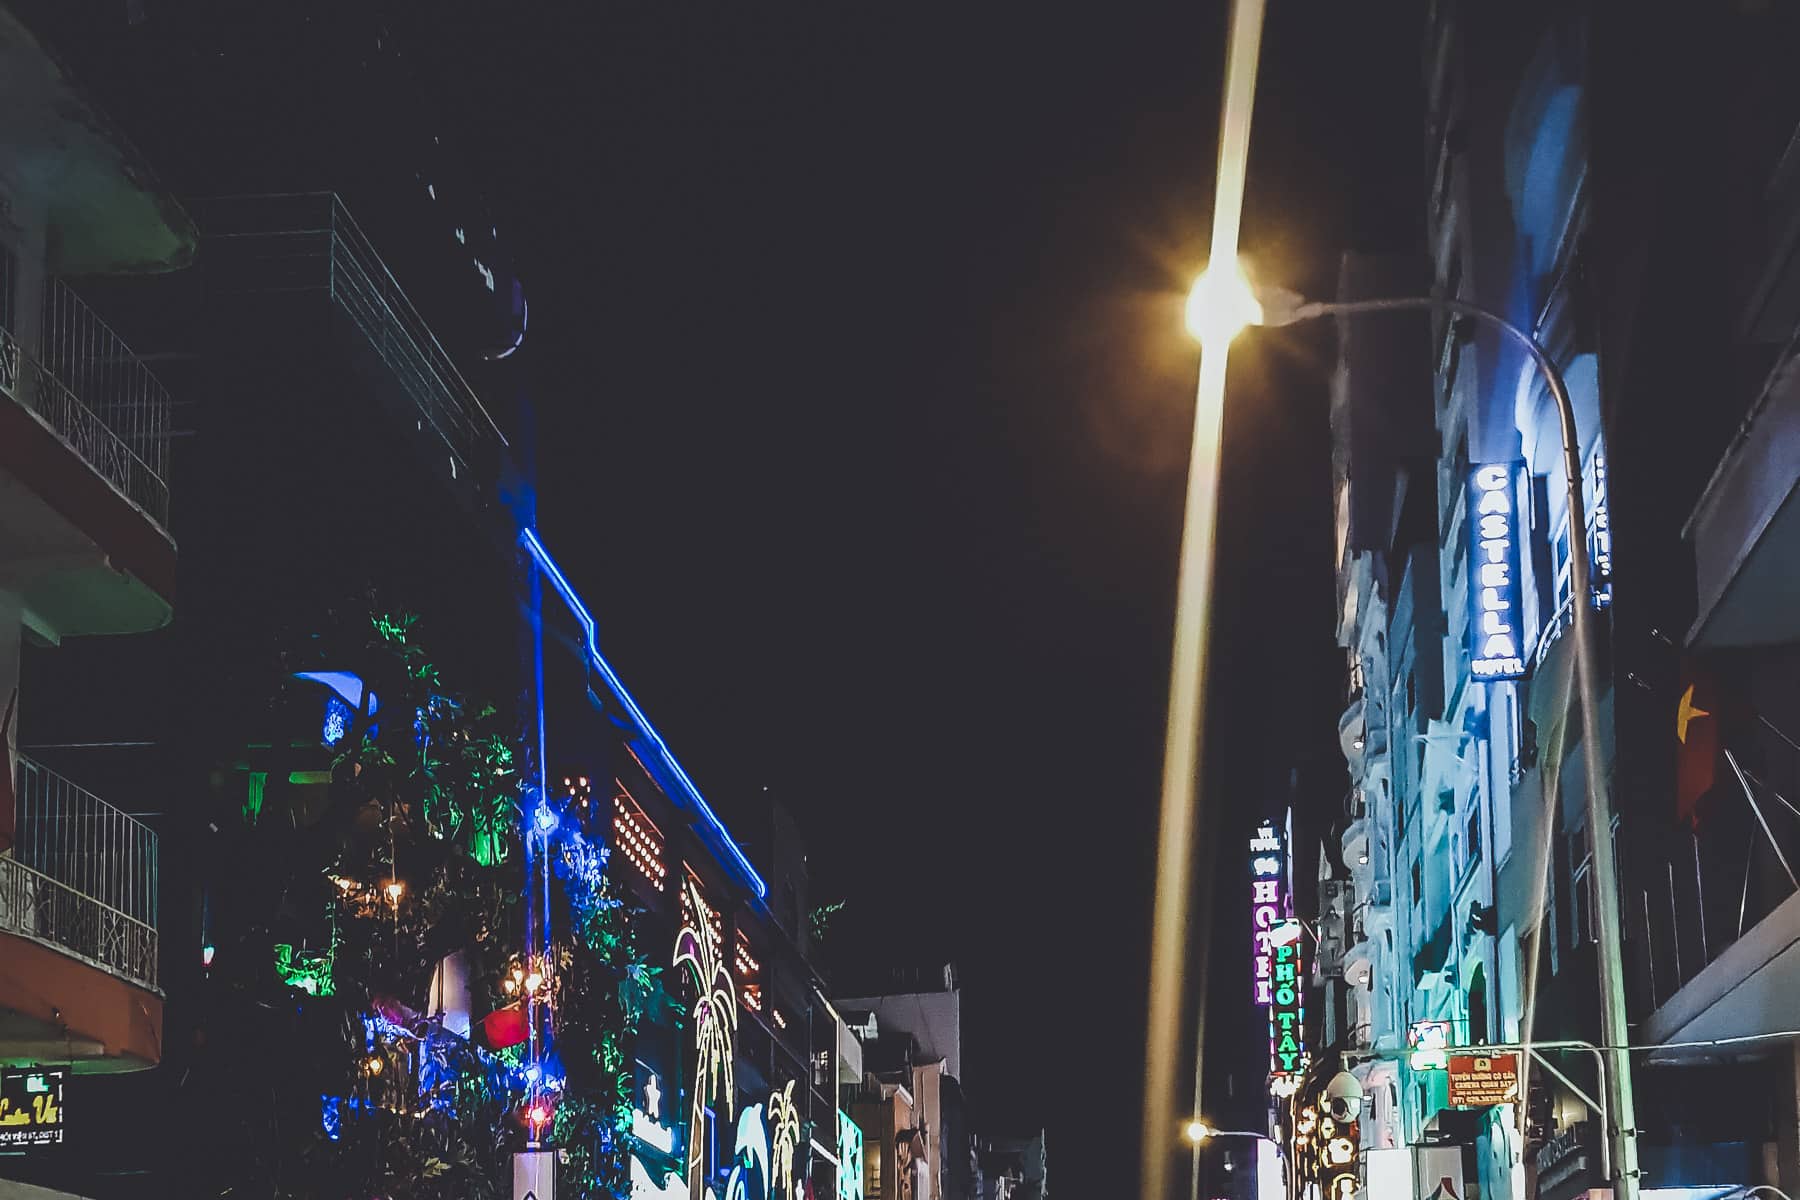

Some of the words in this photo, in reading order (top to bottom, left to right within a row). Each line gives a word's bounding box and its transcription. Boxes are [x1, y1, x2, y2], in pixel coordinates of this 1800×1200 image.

[1477, 466, 1515, 659] CASTELLA
[1275, 945, 1295, 1005] PHỐ
[1277, 1013, 1298, 1070] TÂY
